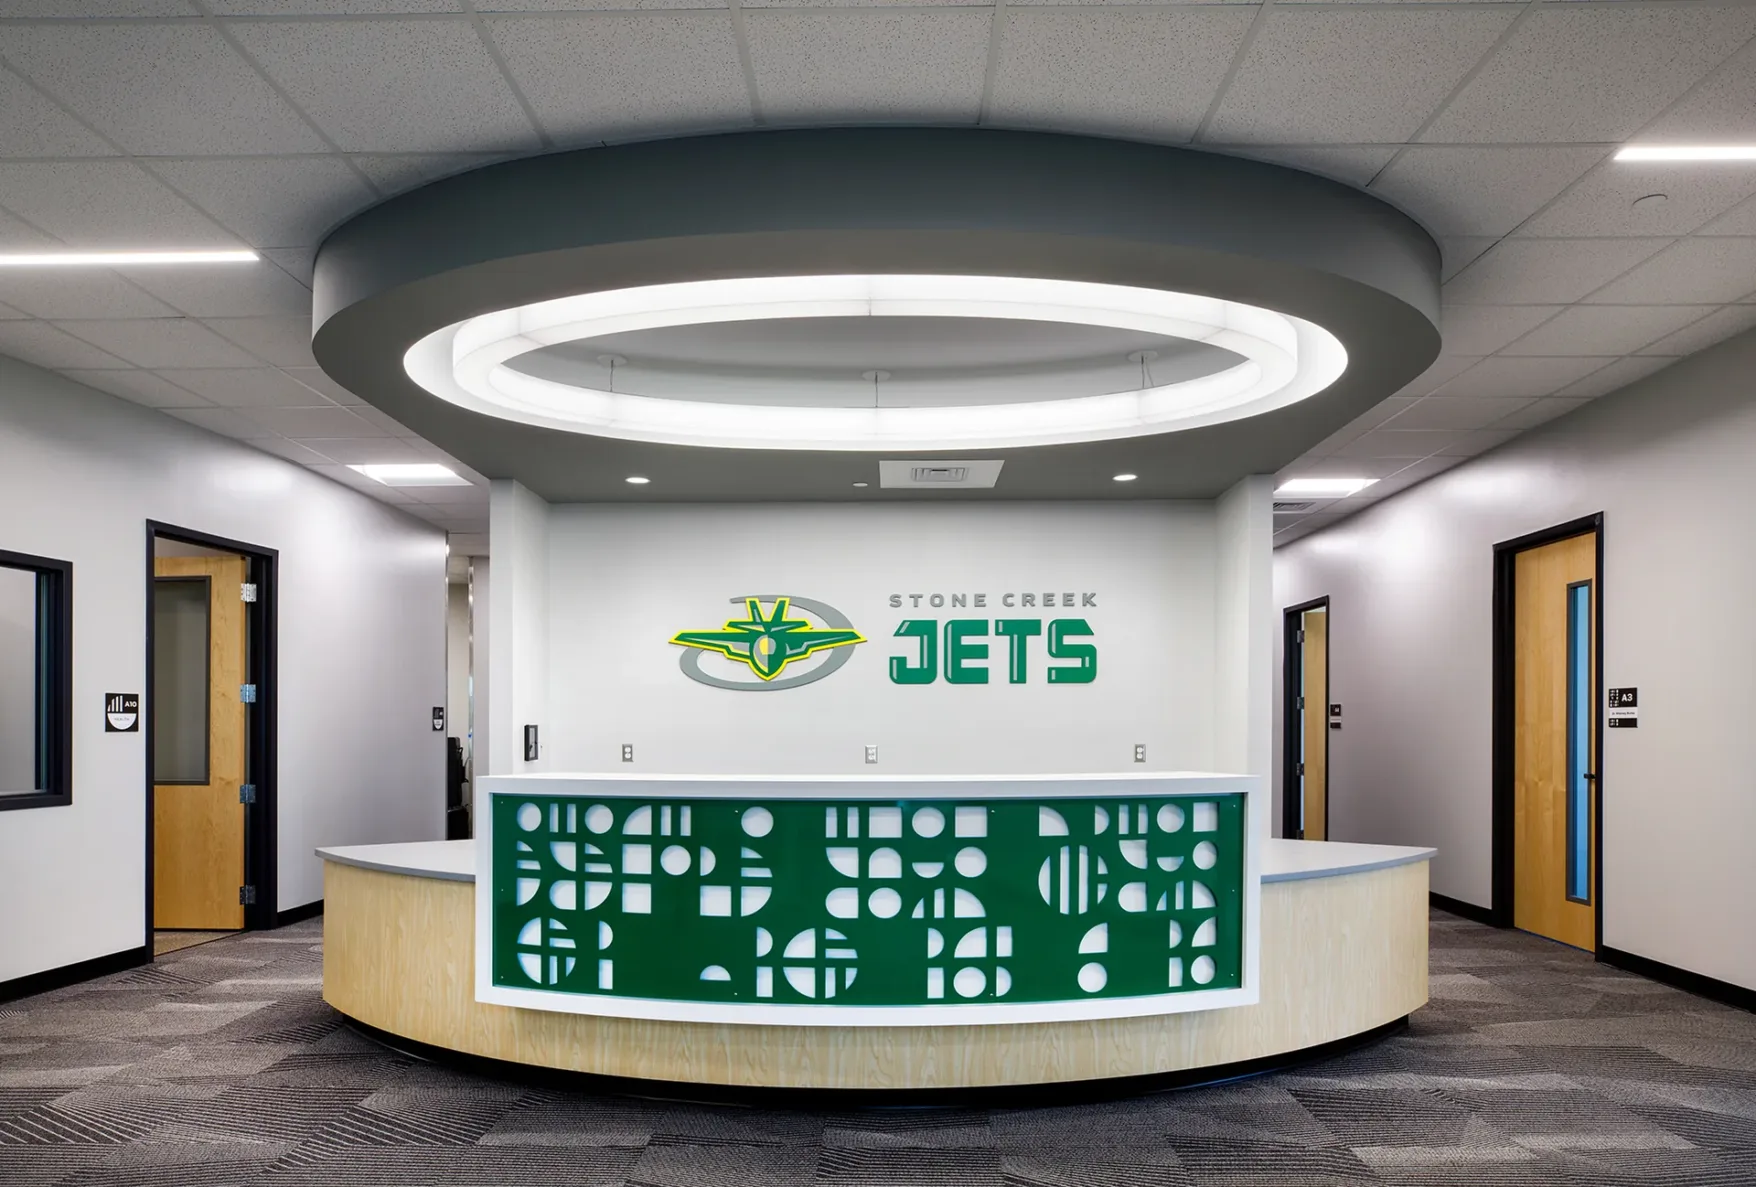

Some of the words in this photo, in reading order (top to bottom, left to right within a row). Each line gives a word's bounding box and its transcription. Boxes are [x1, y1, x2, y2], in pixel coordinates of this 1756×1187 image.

[889, 593, 987, 608] STONE
[1002, 592, 1098, 607] CREEK
[889, 618, 1098, 685] JETS
[1621, 693, 1633, 702] A3
[124, 700, 138, 708] A10
